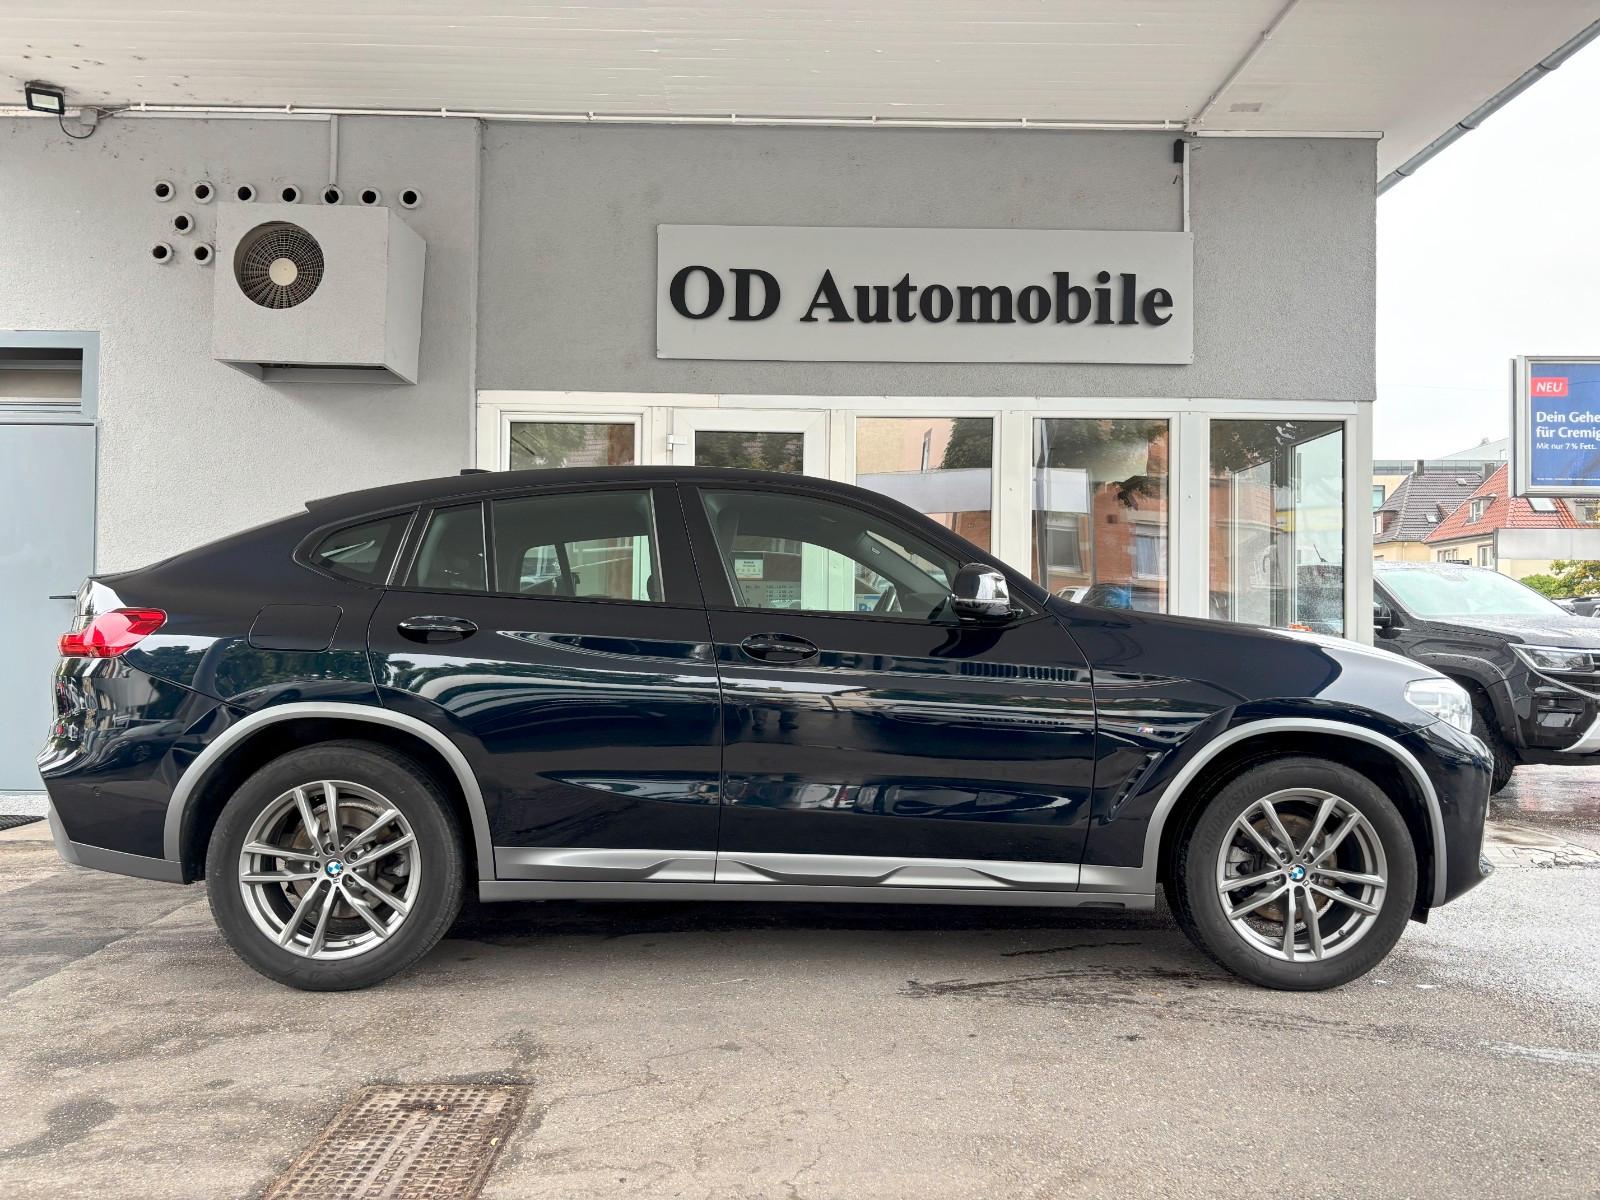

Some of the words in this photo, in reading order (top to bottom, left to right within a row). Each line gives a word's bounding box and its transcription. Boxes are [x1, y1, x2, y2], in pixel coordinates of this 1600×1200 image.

[669, 265, 781, 321] OD
[800, 268, 1174, 326] Automobile
[1536, 381, 1563, 393] NEU
[1536, 411, 1566, 423] Dein
[1535, 425, 1556, 438] für
[1536, 442, 1549, 450] Mit
